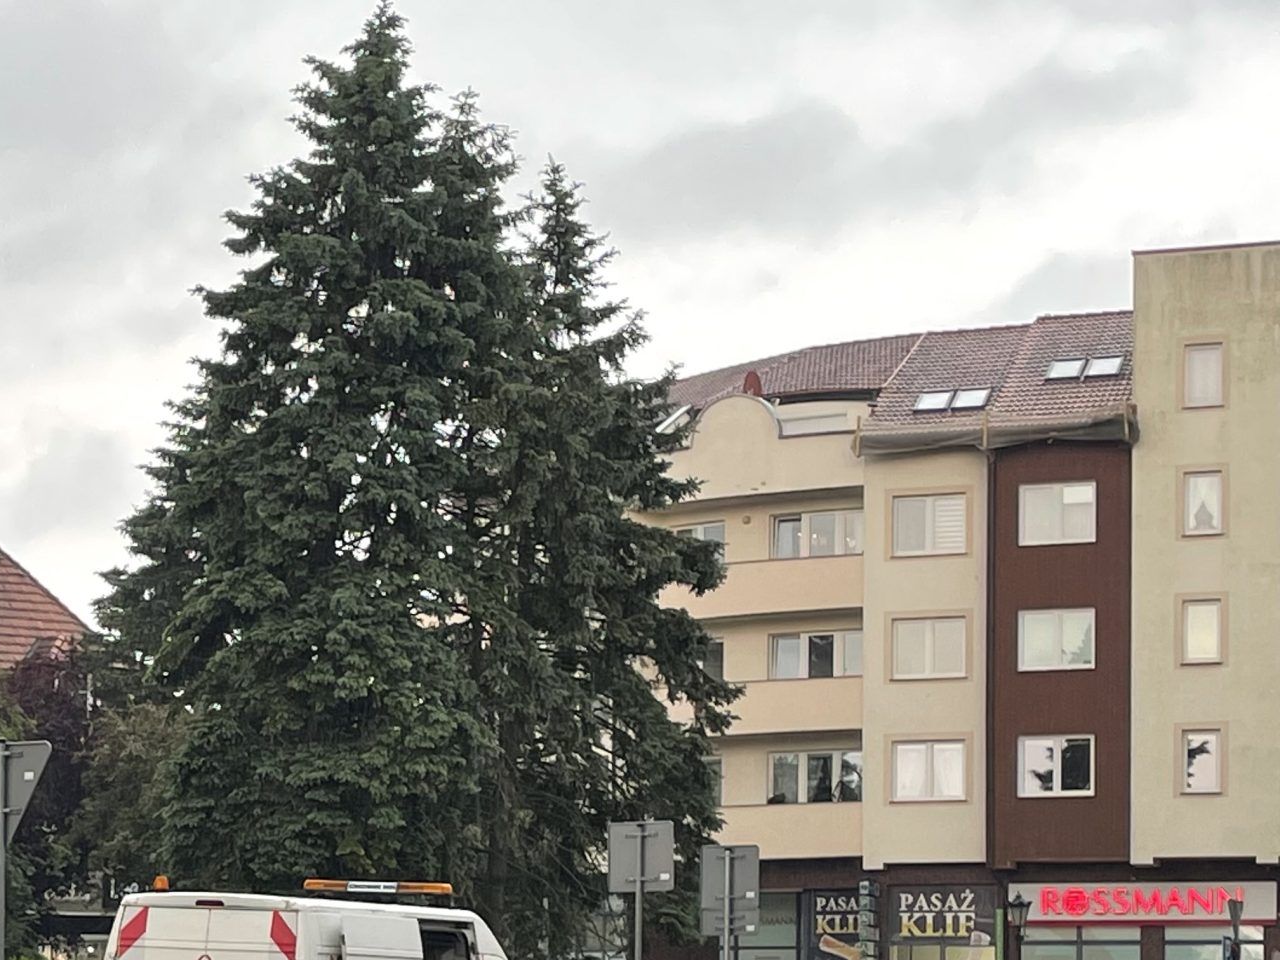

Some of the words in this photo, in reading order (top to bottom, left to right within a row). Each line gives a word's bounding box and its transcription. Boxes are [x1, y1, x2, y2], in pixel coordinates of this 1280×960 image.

[816, 897, 860, 911] PASA
[899, 888, 975, 911] PASAŻ
[1039, 886, 1245, 916] ROSSMANN
[816, 914, 860, 934] KLI
[899, 912, 976, 937] KLIF
